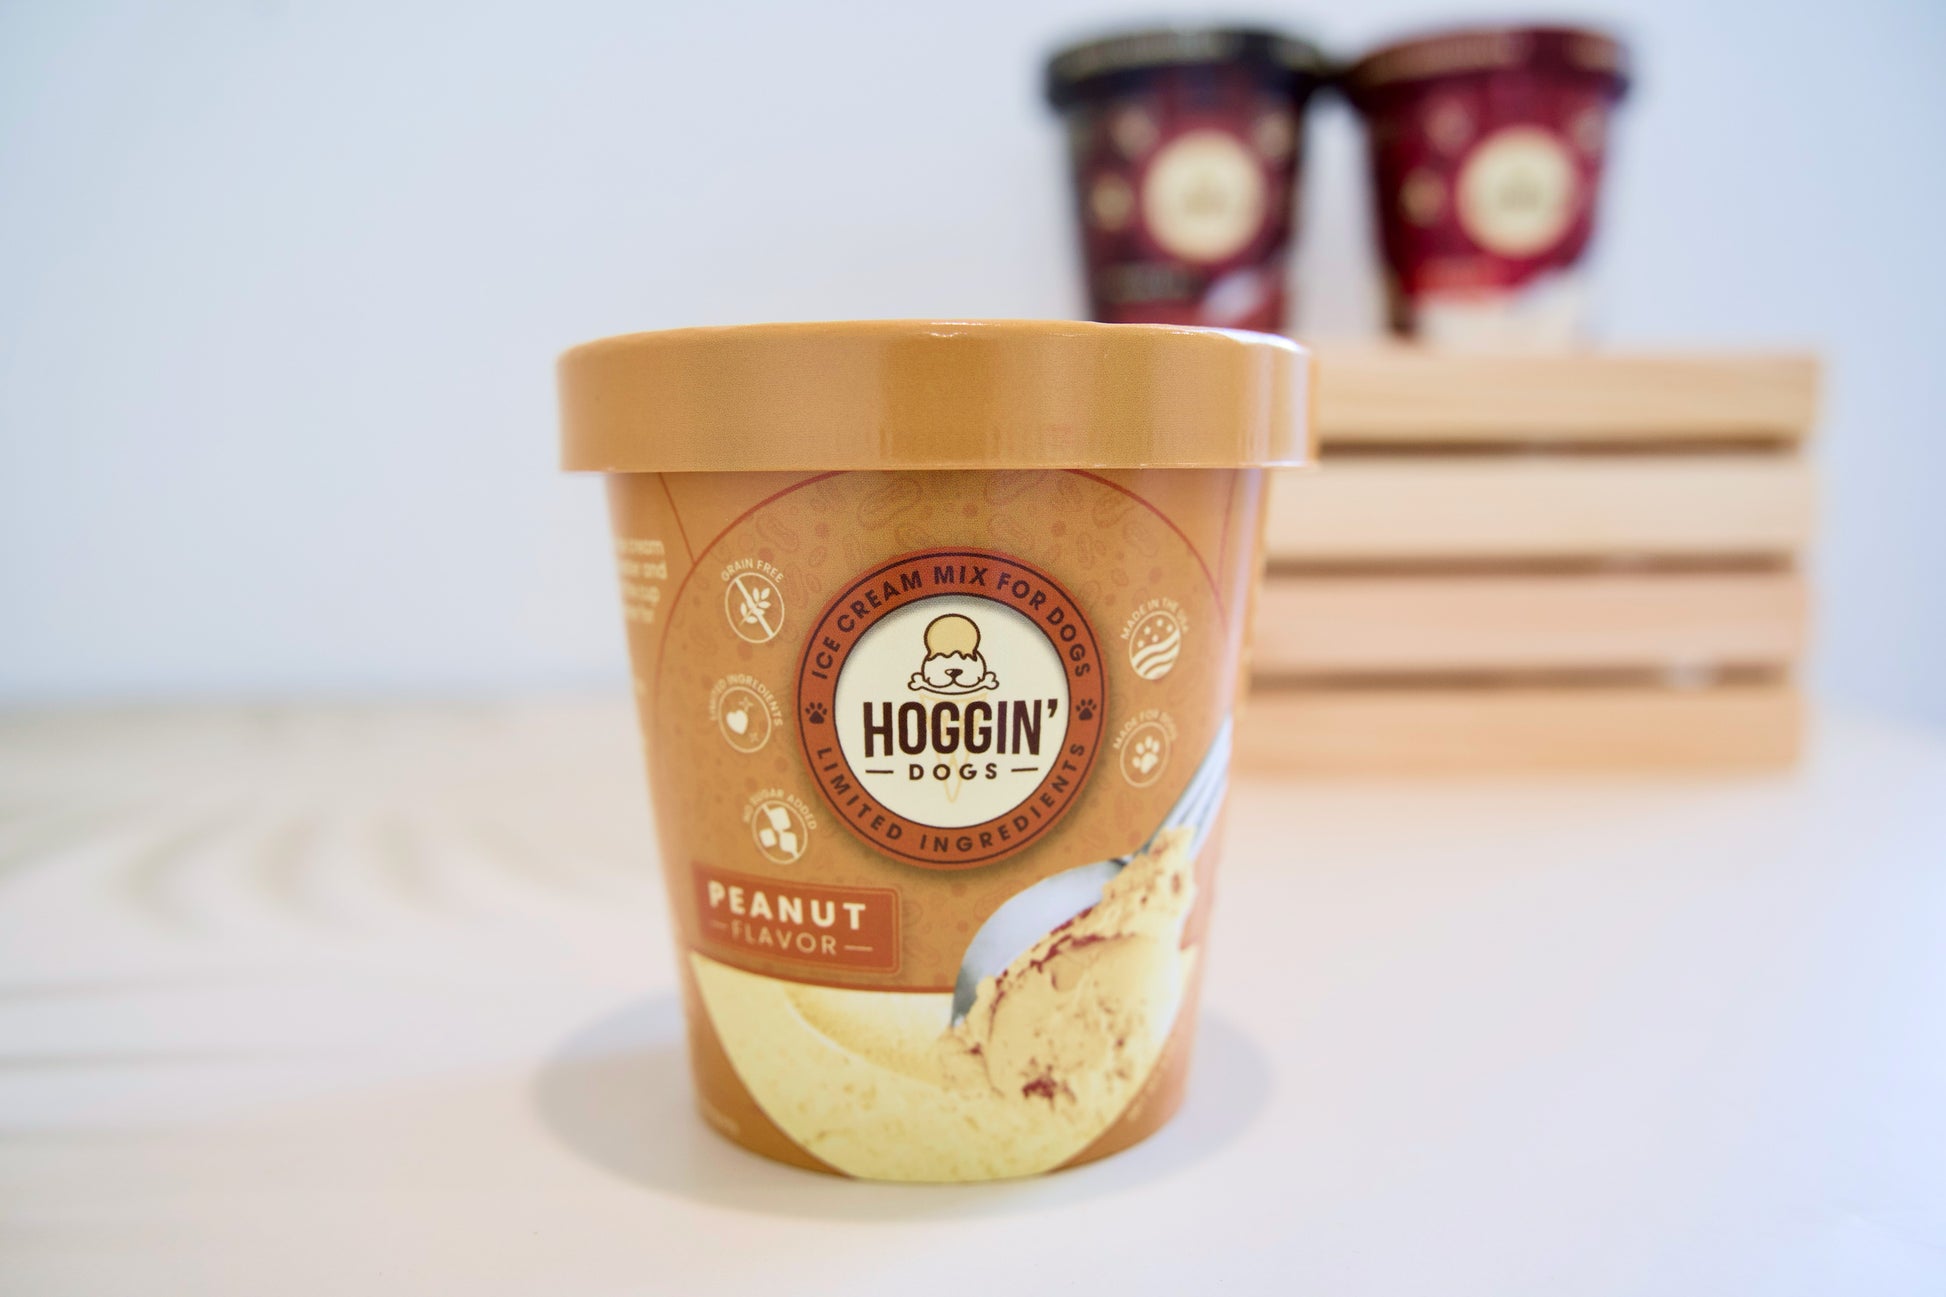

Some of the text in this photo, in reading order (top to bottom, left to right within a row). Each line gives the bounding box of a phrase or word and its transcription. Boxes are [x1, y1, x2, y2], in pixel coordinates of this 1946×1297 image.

[721, 558, 784, 583] GRAIN FREE
[811, 566, 1091, 680] ICE CREAM MIX FOR DOGS
[1121, 604, 1146, 640] MADE
[1147, 598, 1160, 609] IN
[726, 673, 783, 727] INGREDIENTS
[863, 699, 1058, 757] HOGGIN'
[1113, 717, 1138, 749] MADE
[909, 763, 998, 780] DOGS
[786, 794, 816, 830] ADDED
[817, 742, 1085, 852] LIMITED INGREDIENTS
[707, 880, 866, 930] PEANUT
[731, 919, 836, 955] FLAVOR
